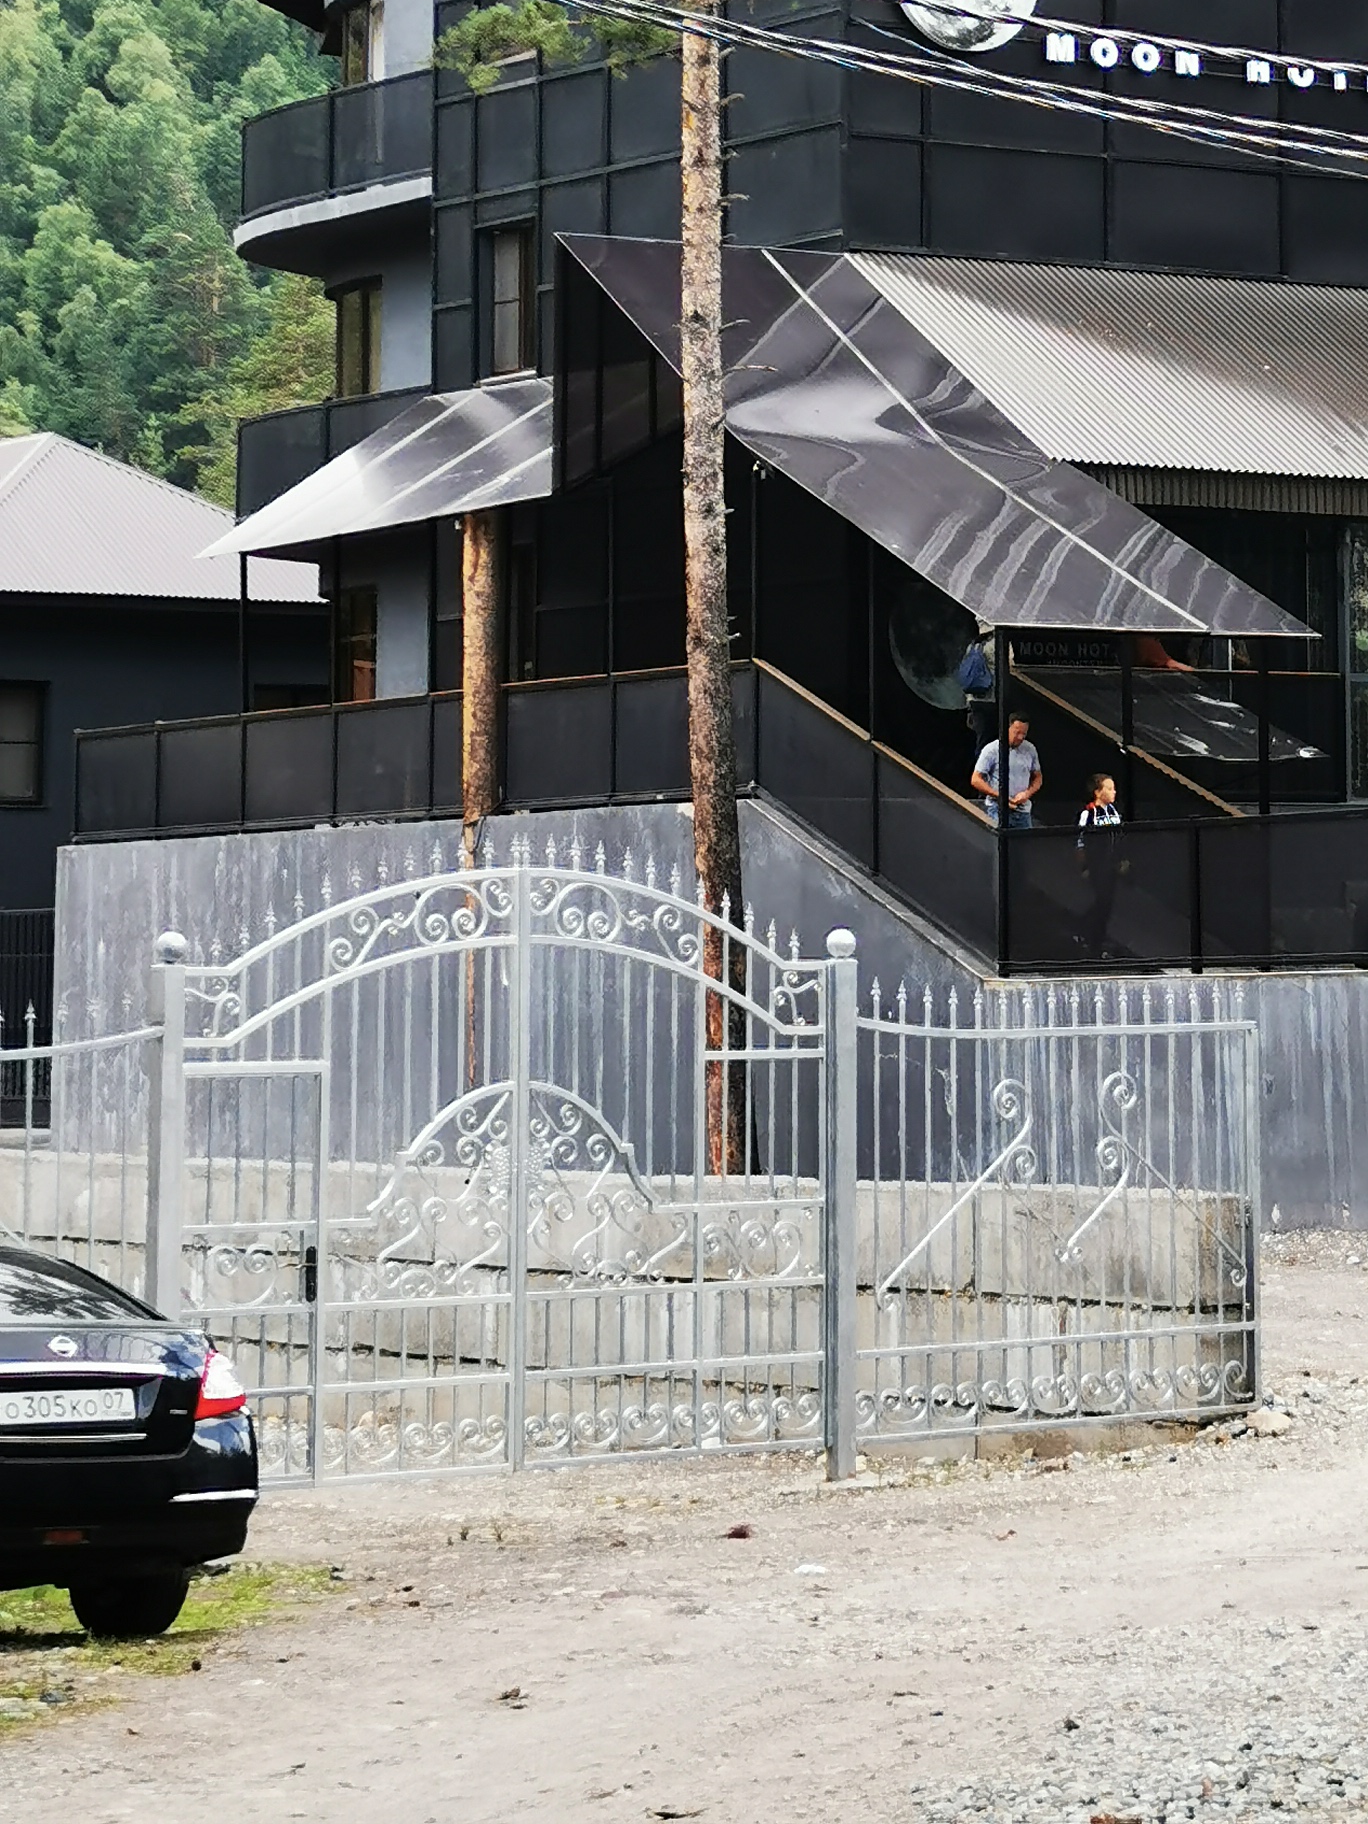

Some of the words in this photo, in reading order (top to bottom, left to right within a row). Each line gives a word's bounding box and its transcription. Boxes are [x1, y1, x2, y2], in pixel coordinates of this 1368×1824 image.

[1045, 32, 1201, 77] MOON
[1019, 641, 1069, 656] MOON
[102, 1391, 124, 1410] 07
